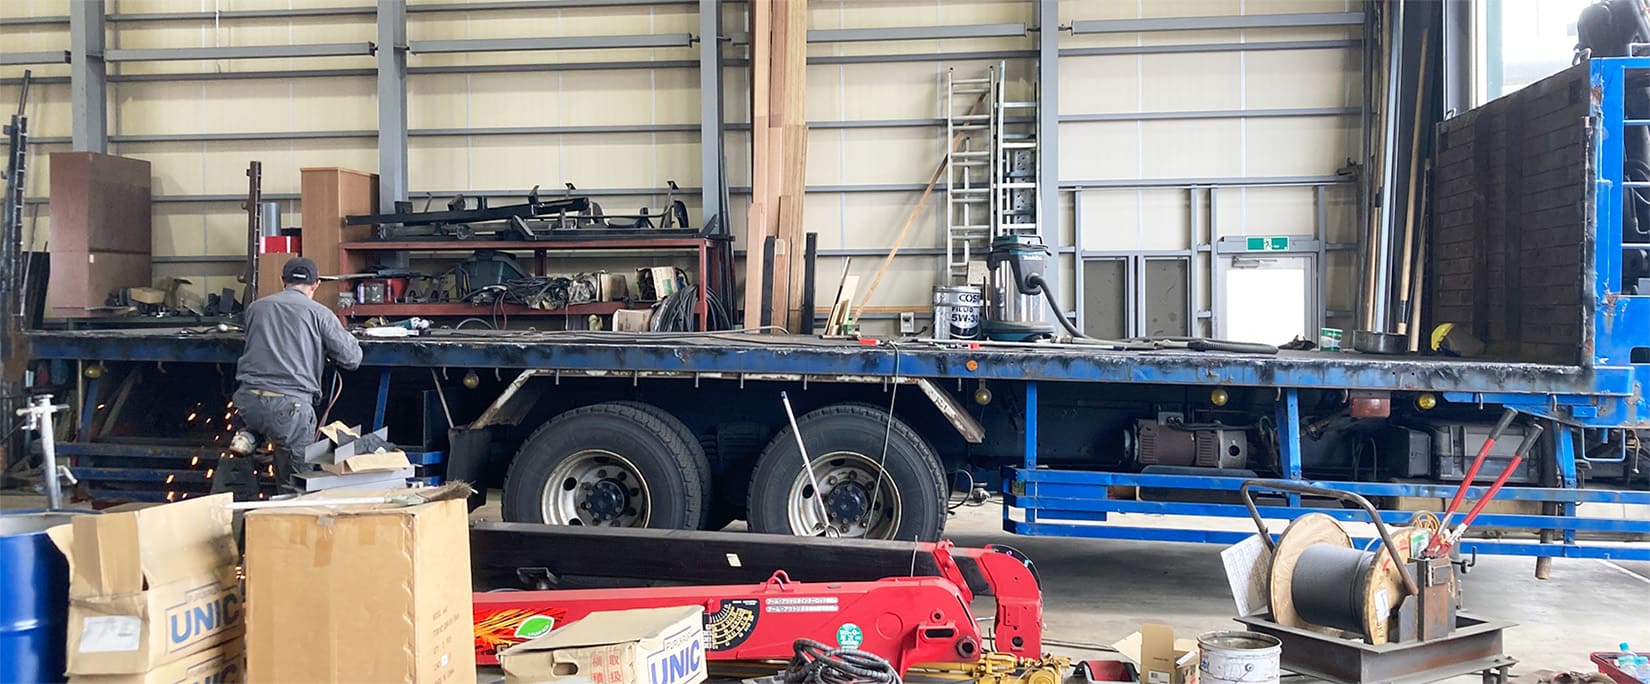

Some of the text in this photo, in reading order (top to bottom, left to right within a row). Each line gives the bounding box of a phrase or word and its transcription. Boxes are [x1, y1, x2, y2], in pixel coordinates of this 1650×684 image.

[959, 294, 980, 304] COS
[171, 593, 240, 644] UNIC
[651, 639, 701, 684] UNIC
